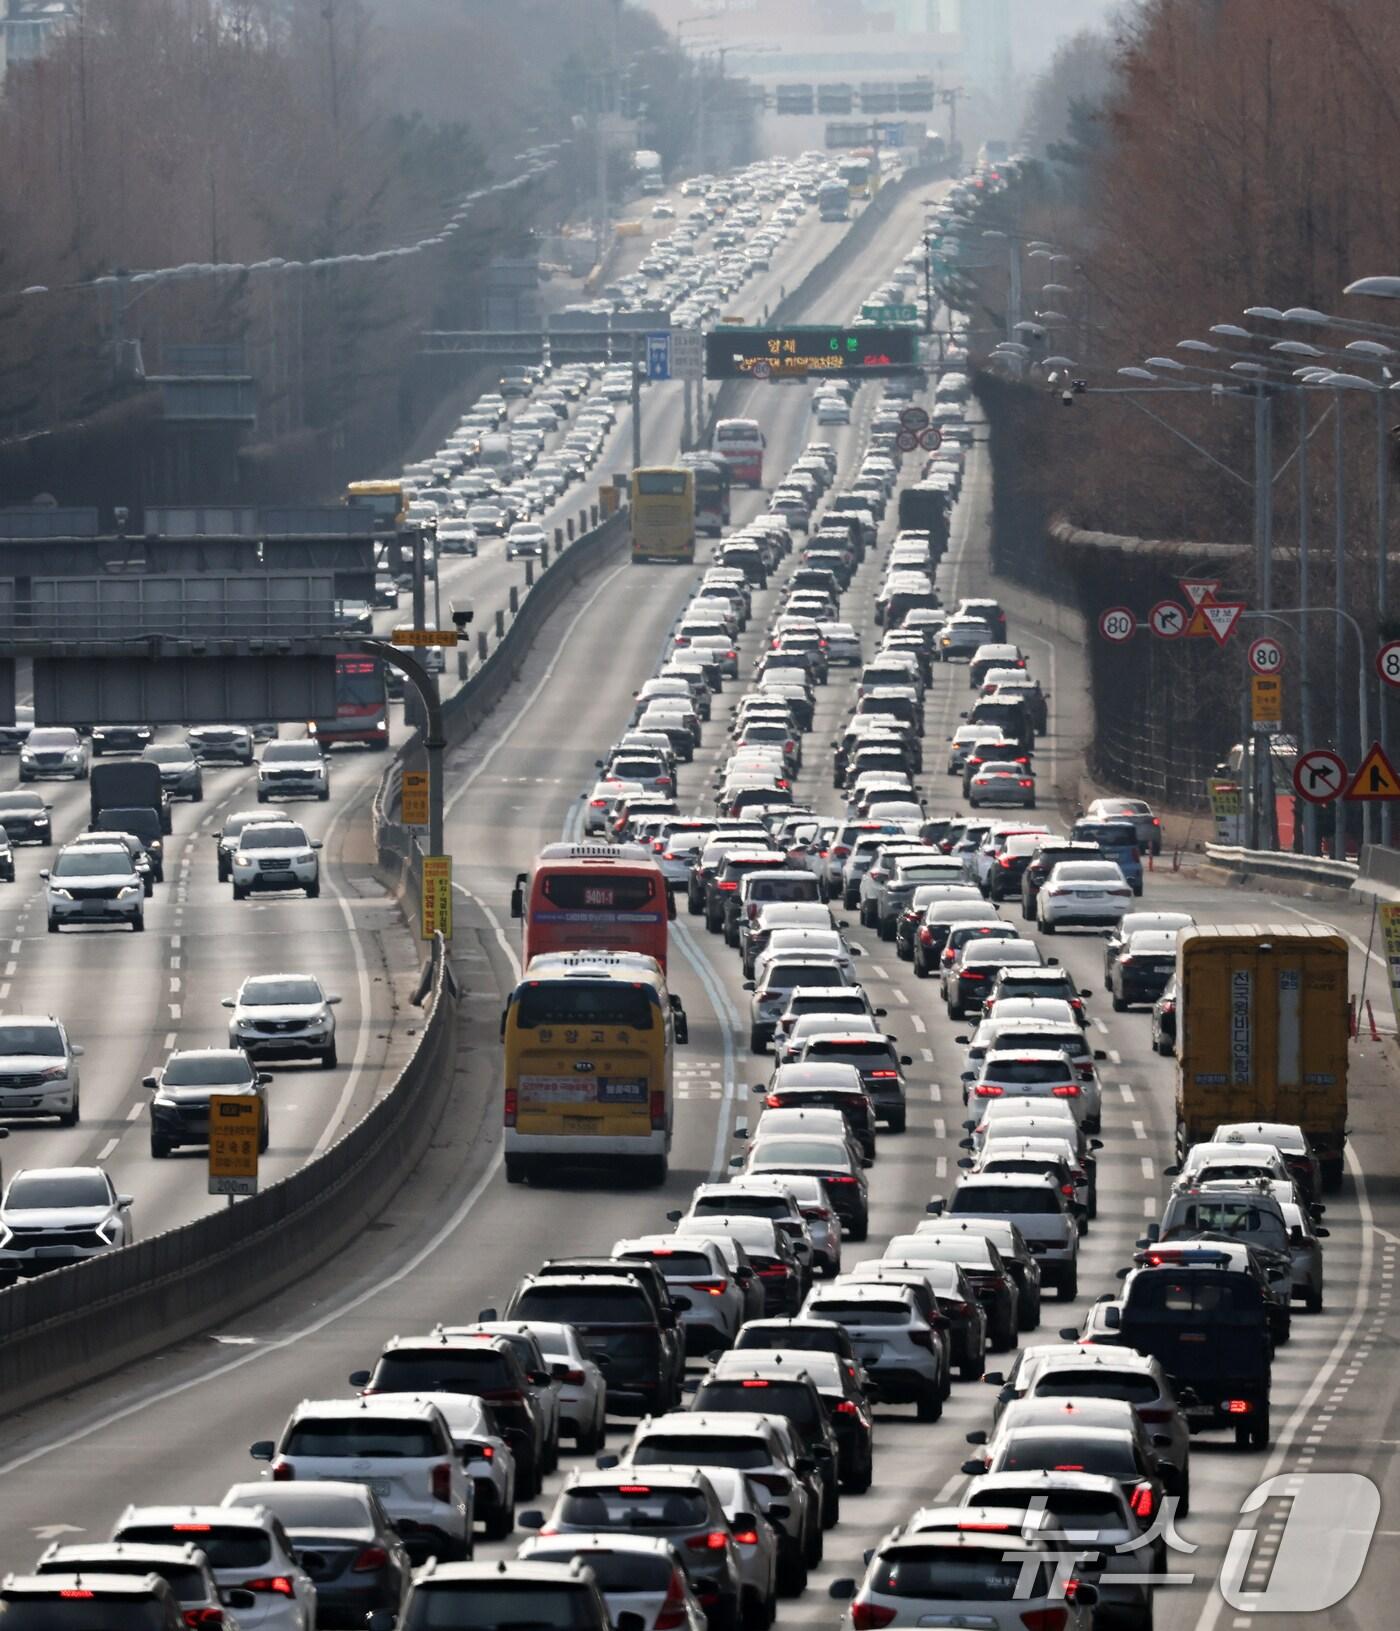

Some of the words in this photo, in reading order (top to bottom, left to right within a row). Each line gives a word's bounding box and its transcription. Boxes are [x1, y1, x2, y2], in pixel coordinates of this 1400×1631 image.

[830, 338, 838, 350] 6
[1107, 616, 1128, 633] 80
[1256, 649, 1278, 665] 80
[1387, 654, 1400, 675] 8
